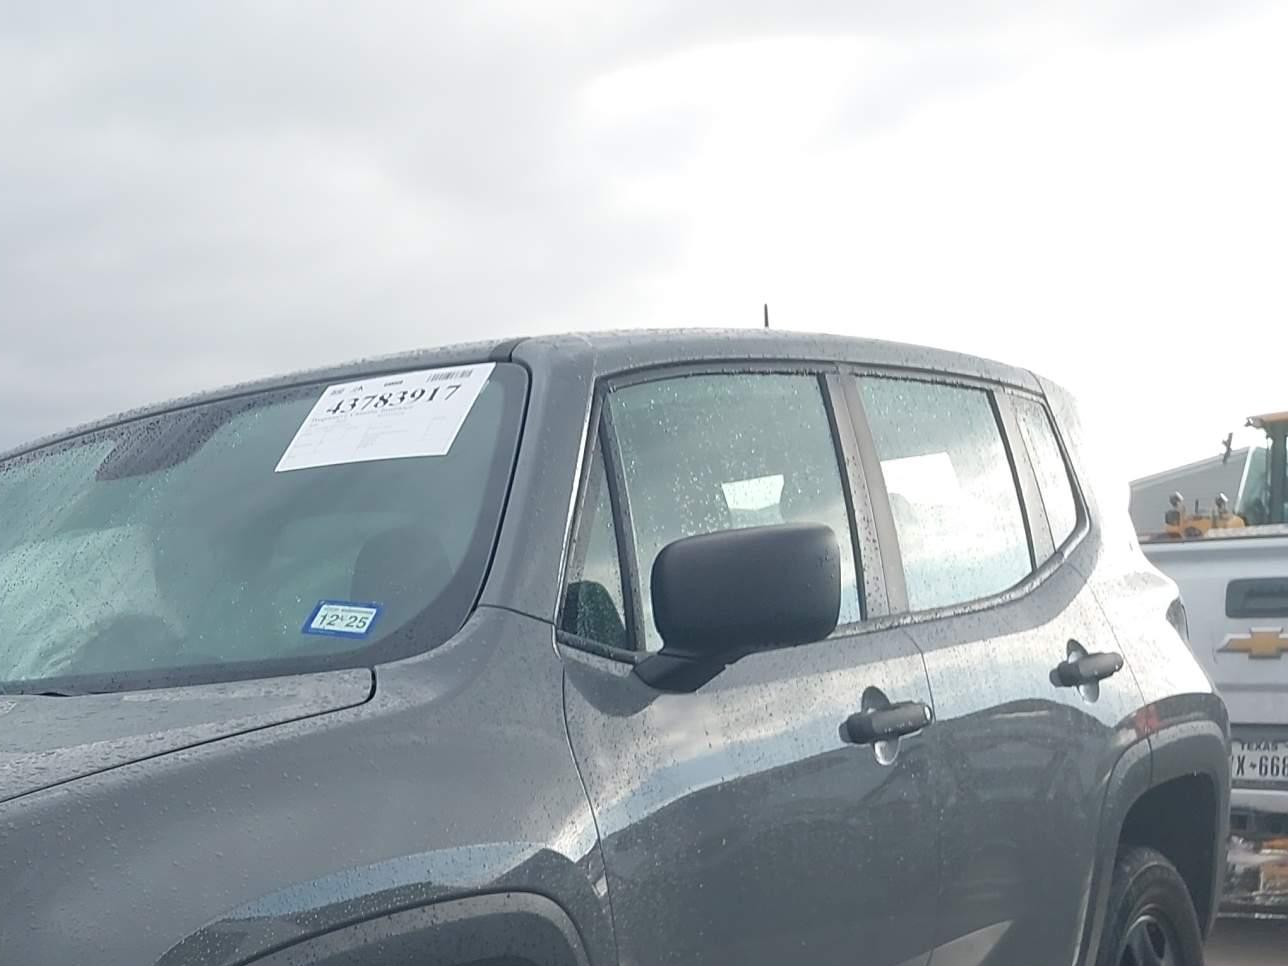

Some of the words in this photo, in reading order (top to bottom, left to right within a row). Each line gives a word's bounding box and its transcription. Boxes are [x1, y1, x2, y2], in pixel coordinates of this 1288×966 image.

[326, 384, 461, 415] 43783917
[344, 615, 369, 629] 25
[1239, 740, 1278, 751] TEXAS
